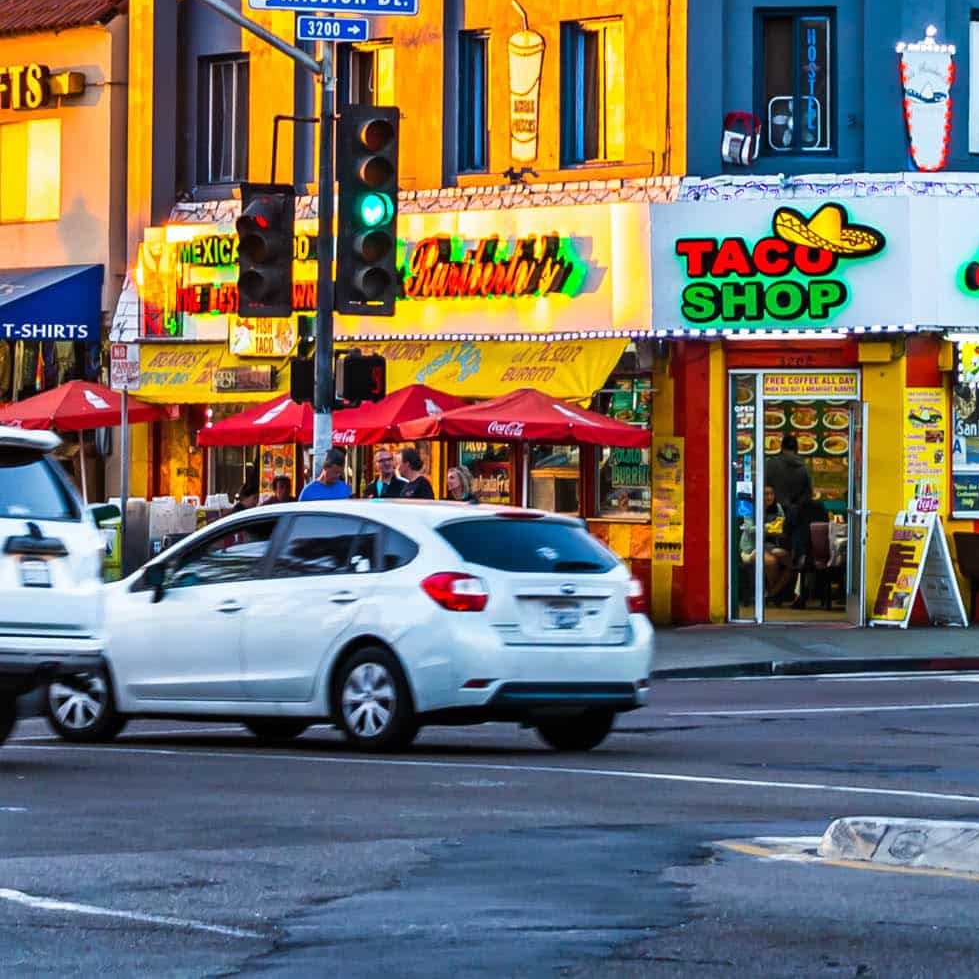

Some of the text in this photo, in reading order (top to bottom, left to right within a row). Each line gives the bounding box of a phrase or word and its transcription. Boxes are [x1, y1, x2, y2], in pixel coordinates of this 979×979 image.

[307, 21, 340, 36] 3200
[806, 28, 817, 130] HOSTEL
[181, 238, 241, 265] MEXICA
[676, 237, 836, 277] TACO
[682, 281, 846, 323] SHOP
[3, 323, 89, 339] T-SHIRTS
[765, 377, 785, 385] FREE
[789, 377, 819, 385] COFFEE
[957, 419, 977, 437] San
